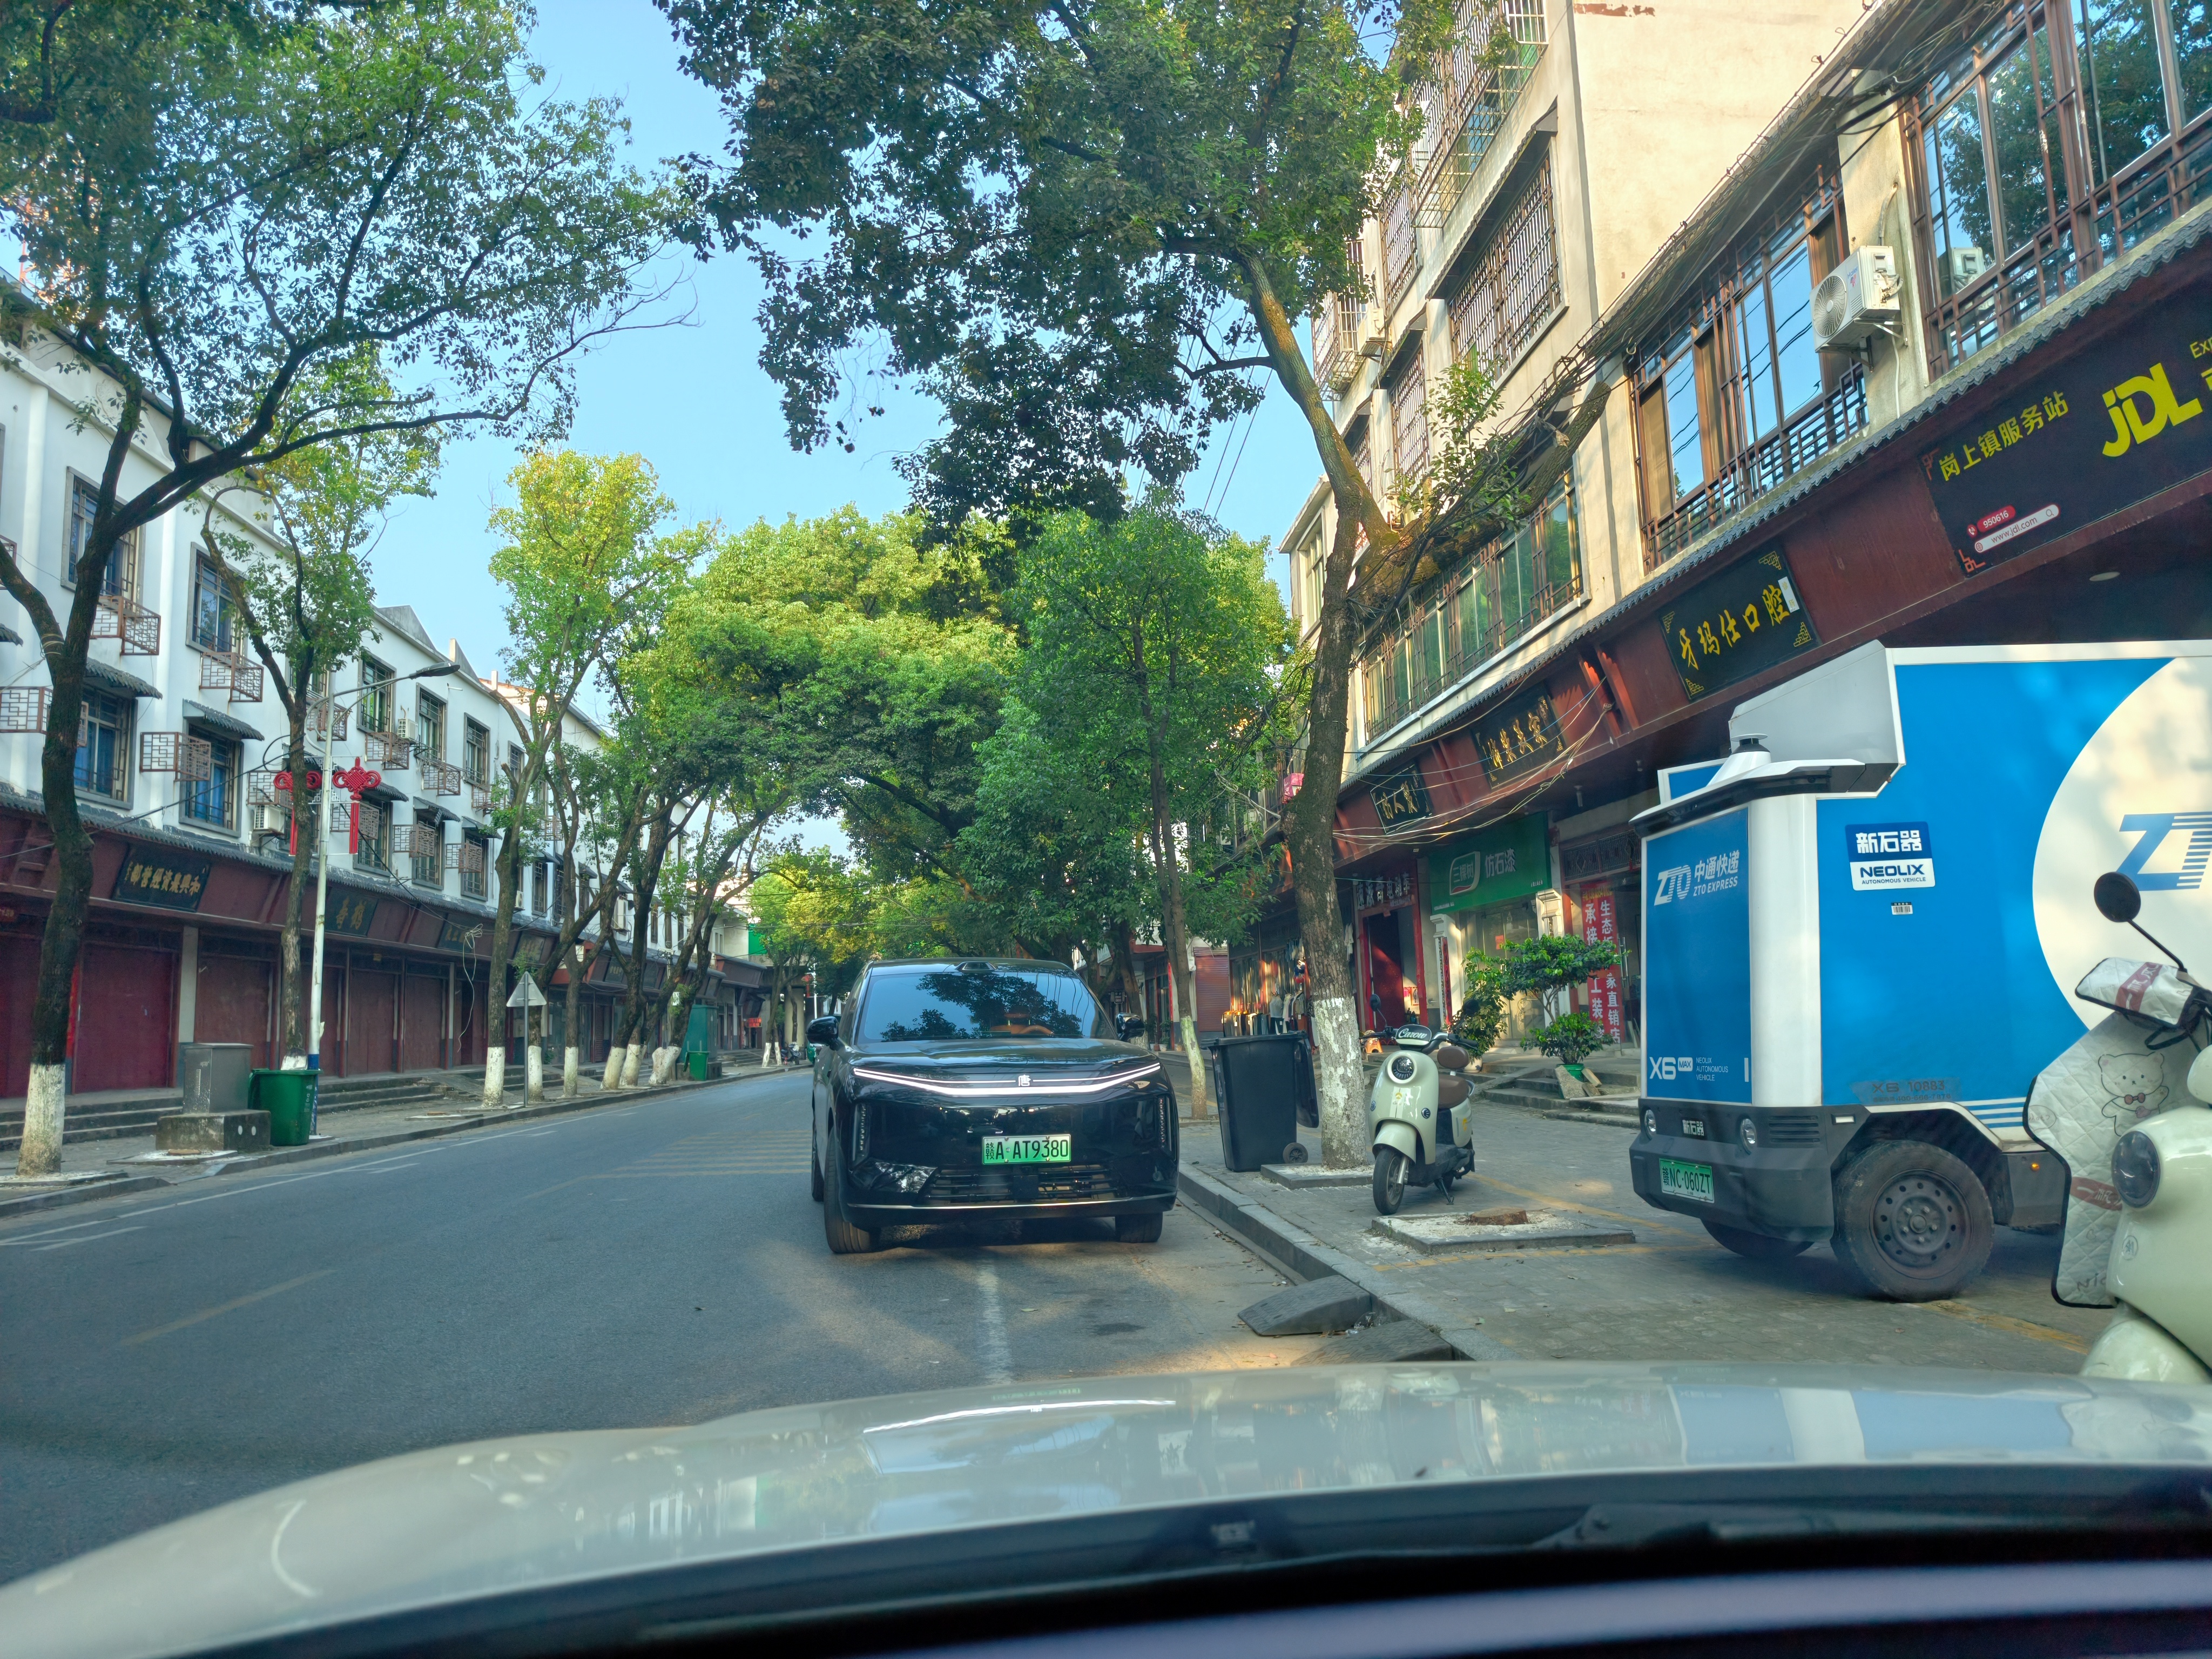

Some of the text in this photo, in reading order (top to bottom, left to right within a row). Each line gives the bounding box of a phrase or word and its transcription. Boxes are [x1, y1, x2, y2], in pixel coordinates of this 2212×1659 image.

[1847, 267, 1858, 279] Haier
[1939, 391, 2069, 481] 岗上镇服务站
[1983, 510, 2009, 528] 950616
[1991, 517, 2038, 544] www.jdl.com
[1680, 584, 1790, 670] 牙玛仕口腔
[1856, 830, 1922, 854] 新石器
[1453, 861, 1474, 883] 三棵树
[1486, 848, 1516, 878] 仿石漆
[1695, 849, 1740, 882] 中通快递
[1860, 864, 1925, 878] NEOLIX
[1654, 865, 1691, 906] ZTO
[1693, 876, 1738, 896] ZTO EXPRESS
[1649, 1057, 1691, 1080] X6 MAX
[1872, 1080, 1945, 1093] X6 10883
[1682, 1120, 1704, 1136] 新石器
